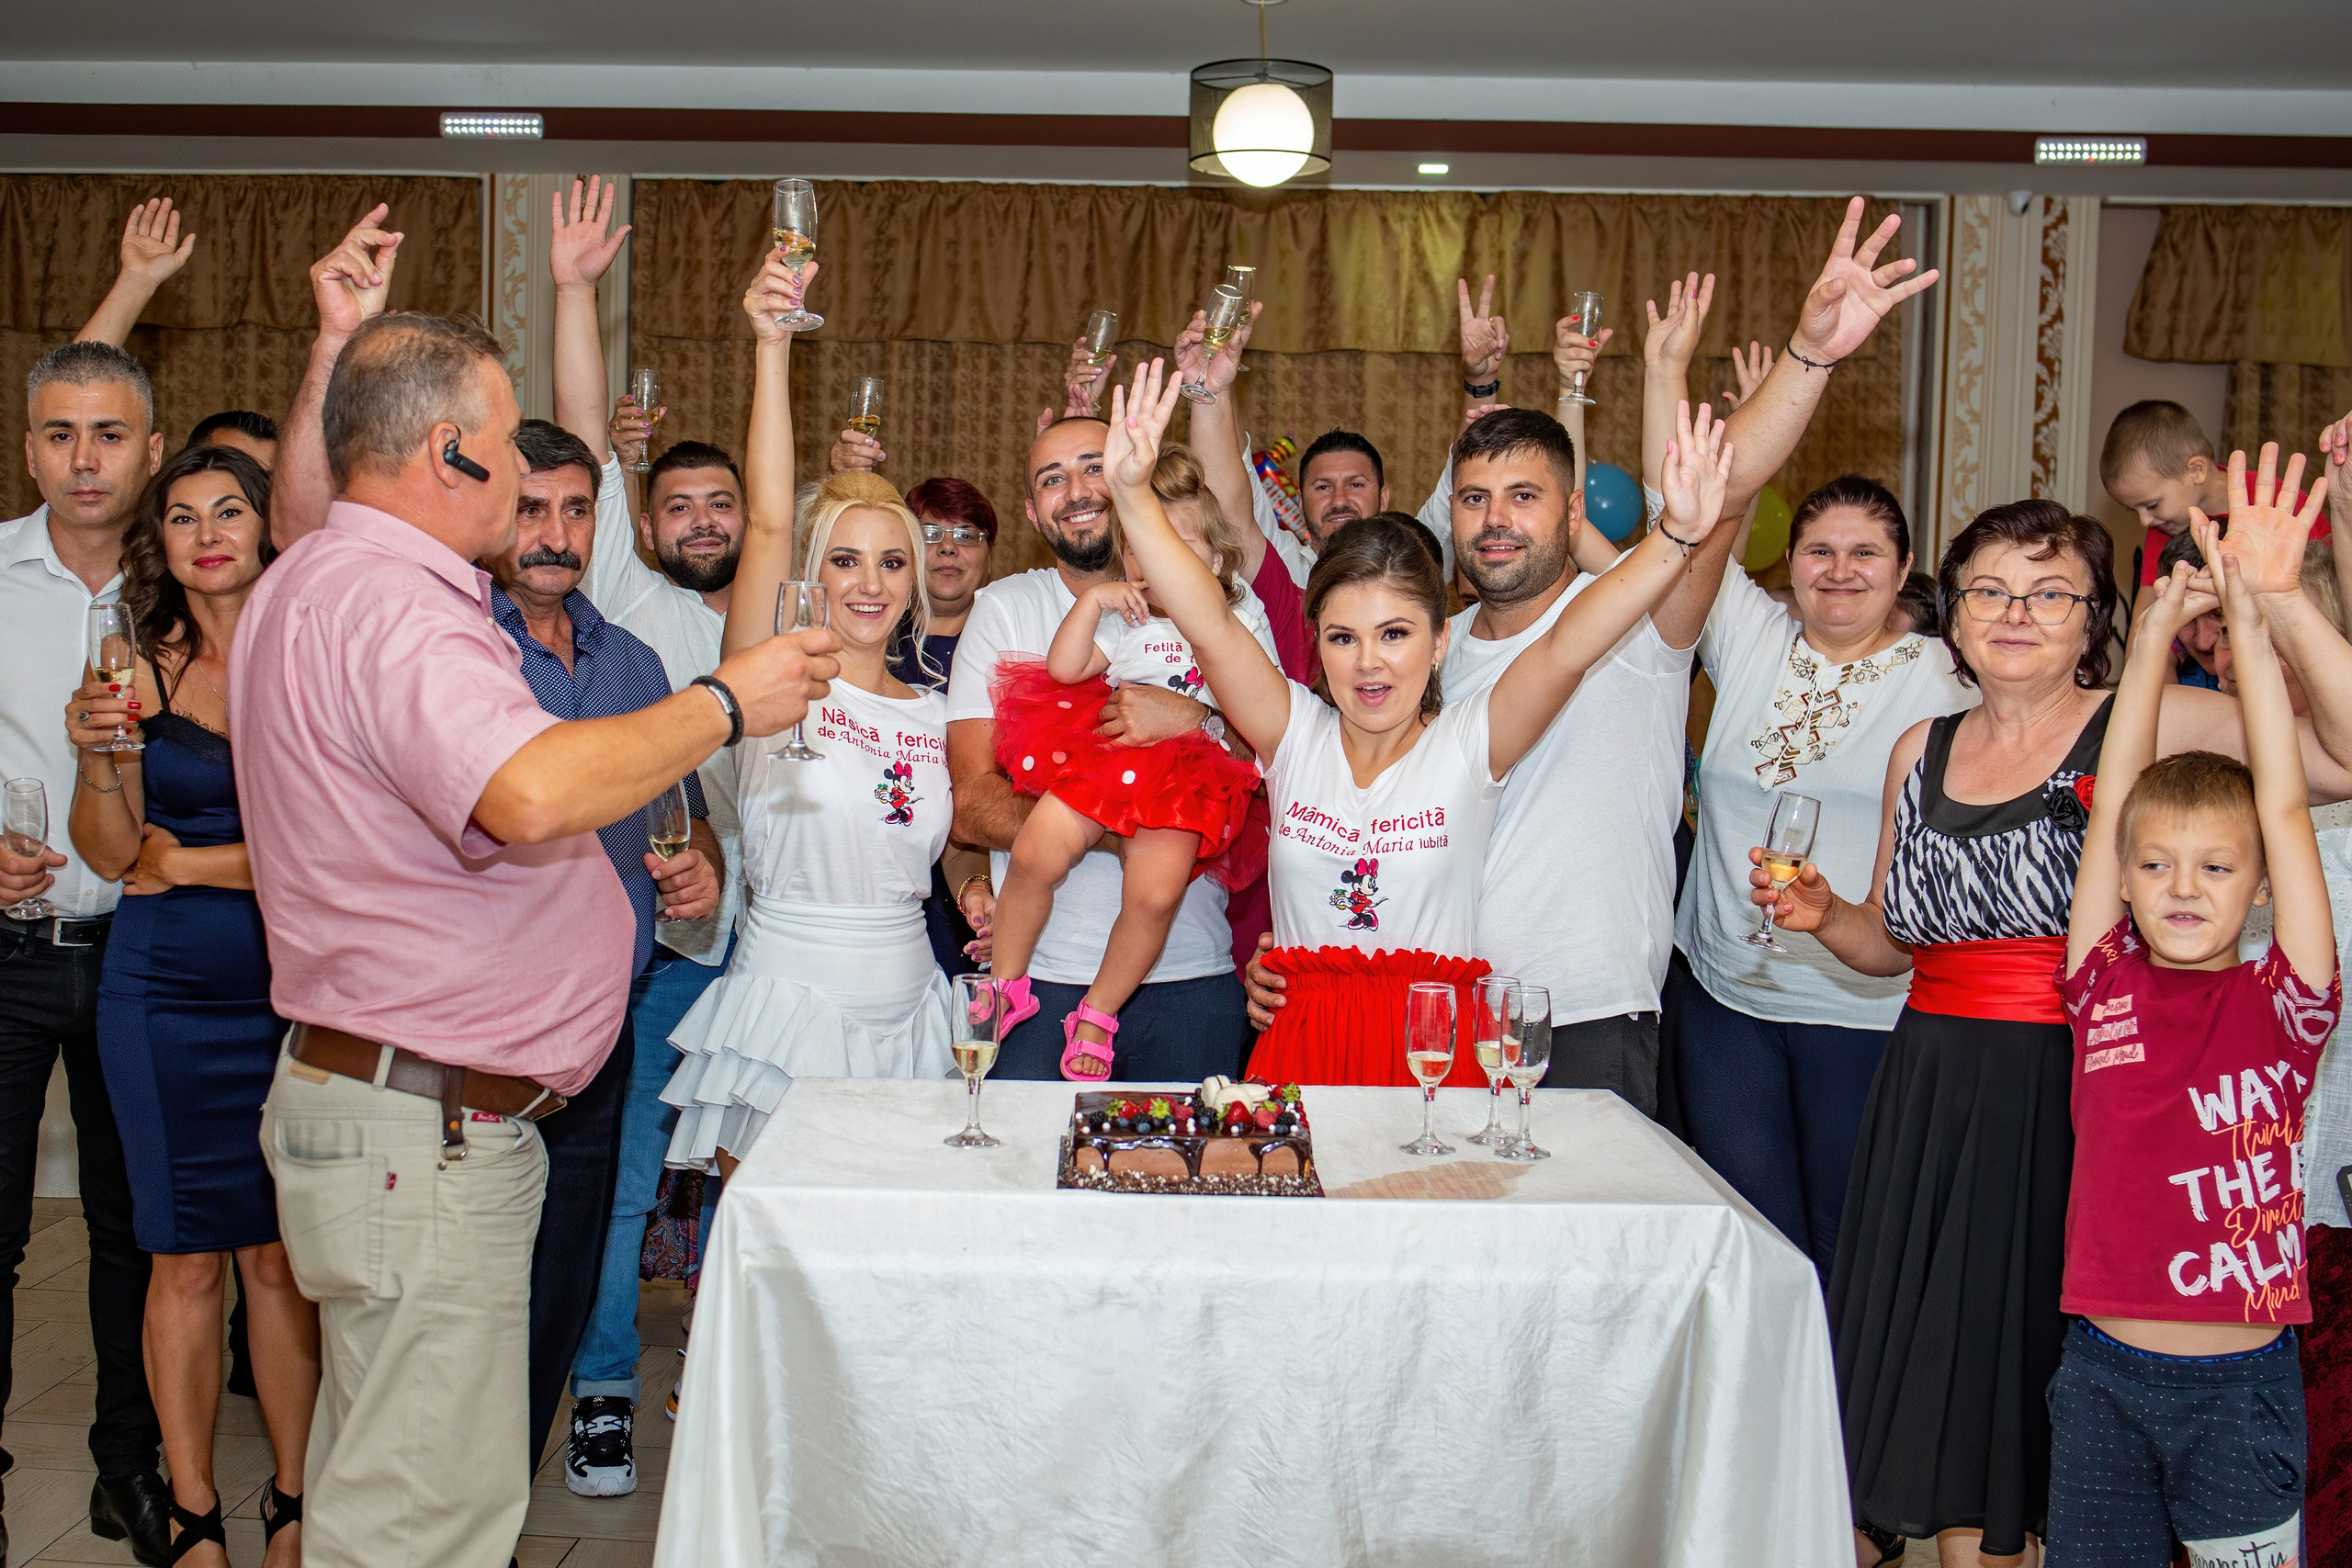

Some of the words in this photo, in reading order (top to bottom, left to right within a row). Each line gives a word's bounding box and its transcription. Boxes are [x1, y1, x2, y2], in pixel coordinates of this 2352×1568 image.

[1165, 653, 1181, 663] de
[818, 726, 836, 739] de
[838, 730, 891, 759] Antonia
[896, 750, 939, 764] Maria
[896, 731, 947, 756] fericit
[1278, 821, 1291, 837] de
[1290, 827, 1356, 856] Antonia
[1363, 837, 1414, 856] Maria
[2167, 1151, 2281, 1222] THE
[2167, 1224, 2301, 1296] CALM
[2245, 1262, 2304, 1323] Mind
